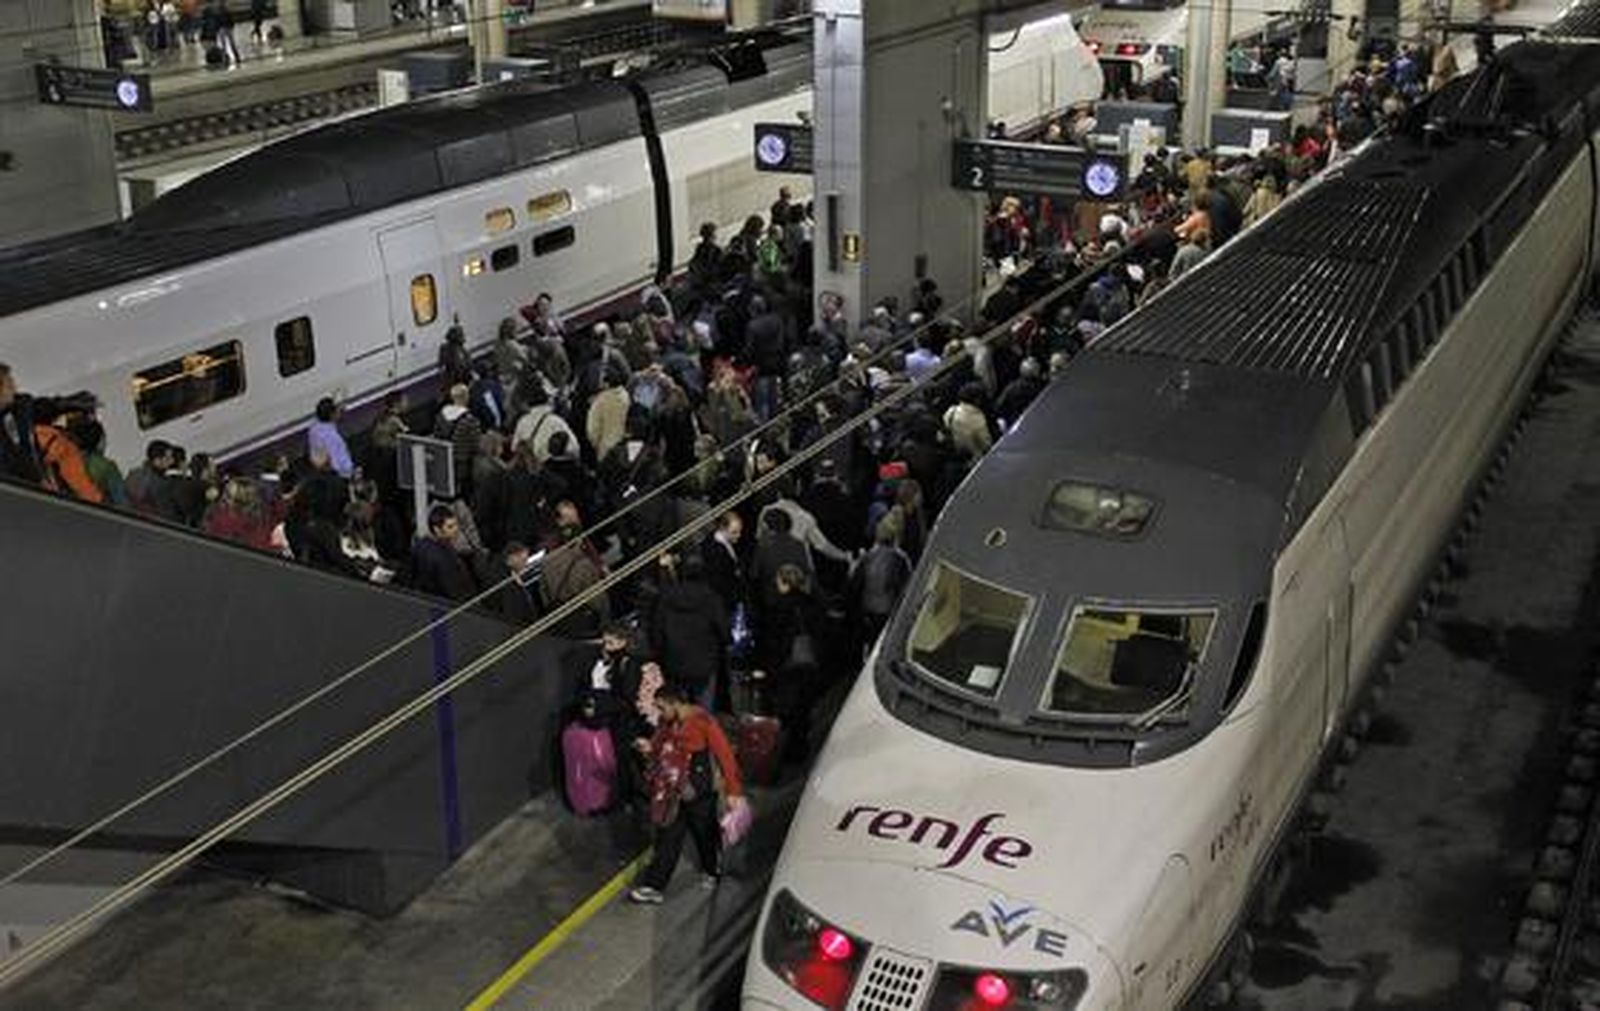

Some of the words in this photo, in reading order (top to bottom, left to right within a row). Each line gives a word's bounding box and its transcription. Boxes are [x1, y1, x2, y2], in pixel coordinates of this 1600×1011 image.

[970, 167, 984, 187] 2
[836, 806, 1032, 869] renfe
[950, 902, 1067, 957] AVE
